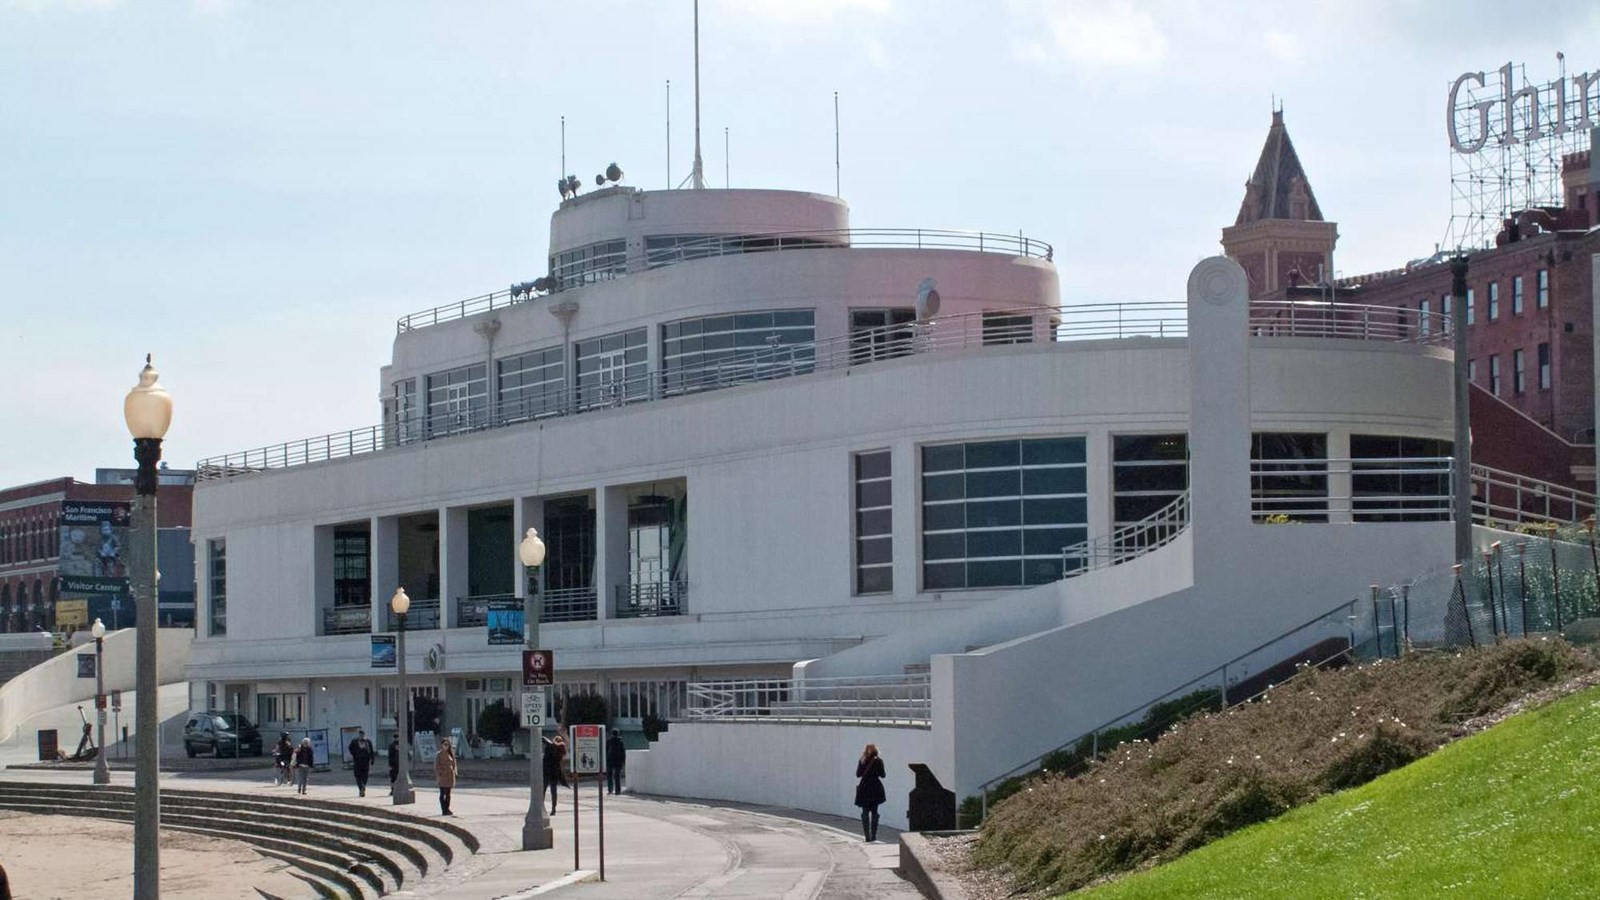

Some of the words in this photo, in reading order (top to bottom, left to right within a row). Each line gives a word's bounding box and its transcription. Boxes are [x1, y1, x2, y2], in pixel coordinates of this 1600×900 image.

[1446, 53, 1600, 154] Ghir
[68, 581, 93, 590] Visitor
[95, 583, 122, 592] Center
[527, 714, 540, 725] 10
